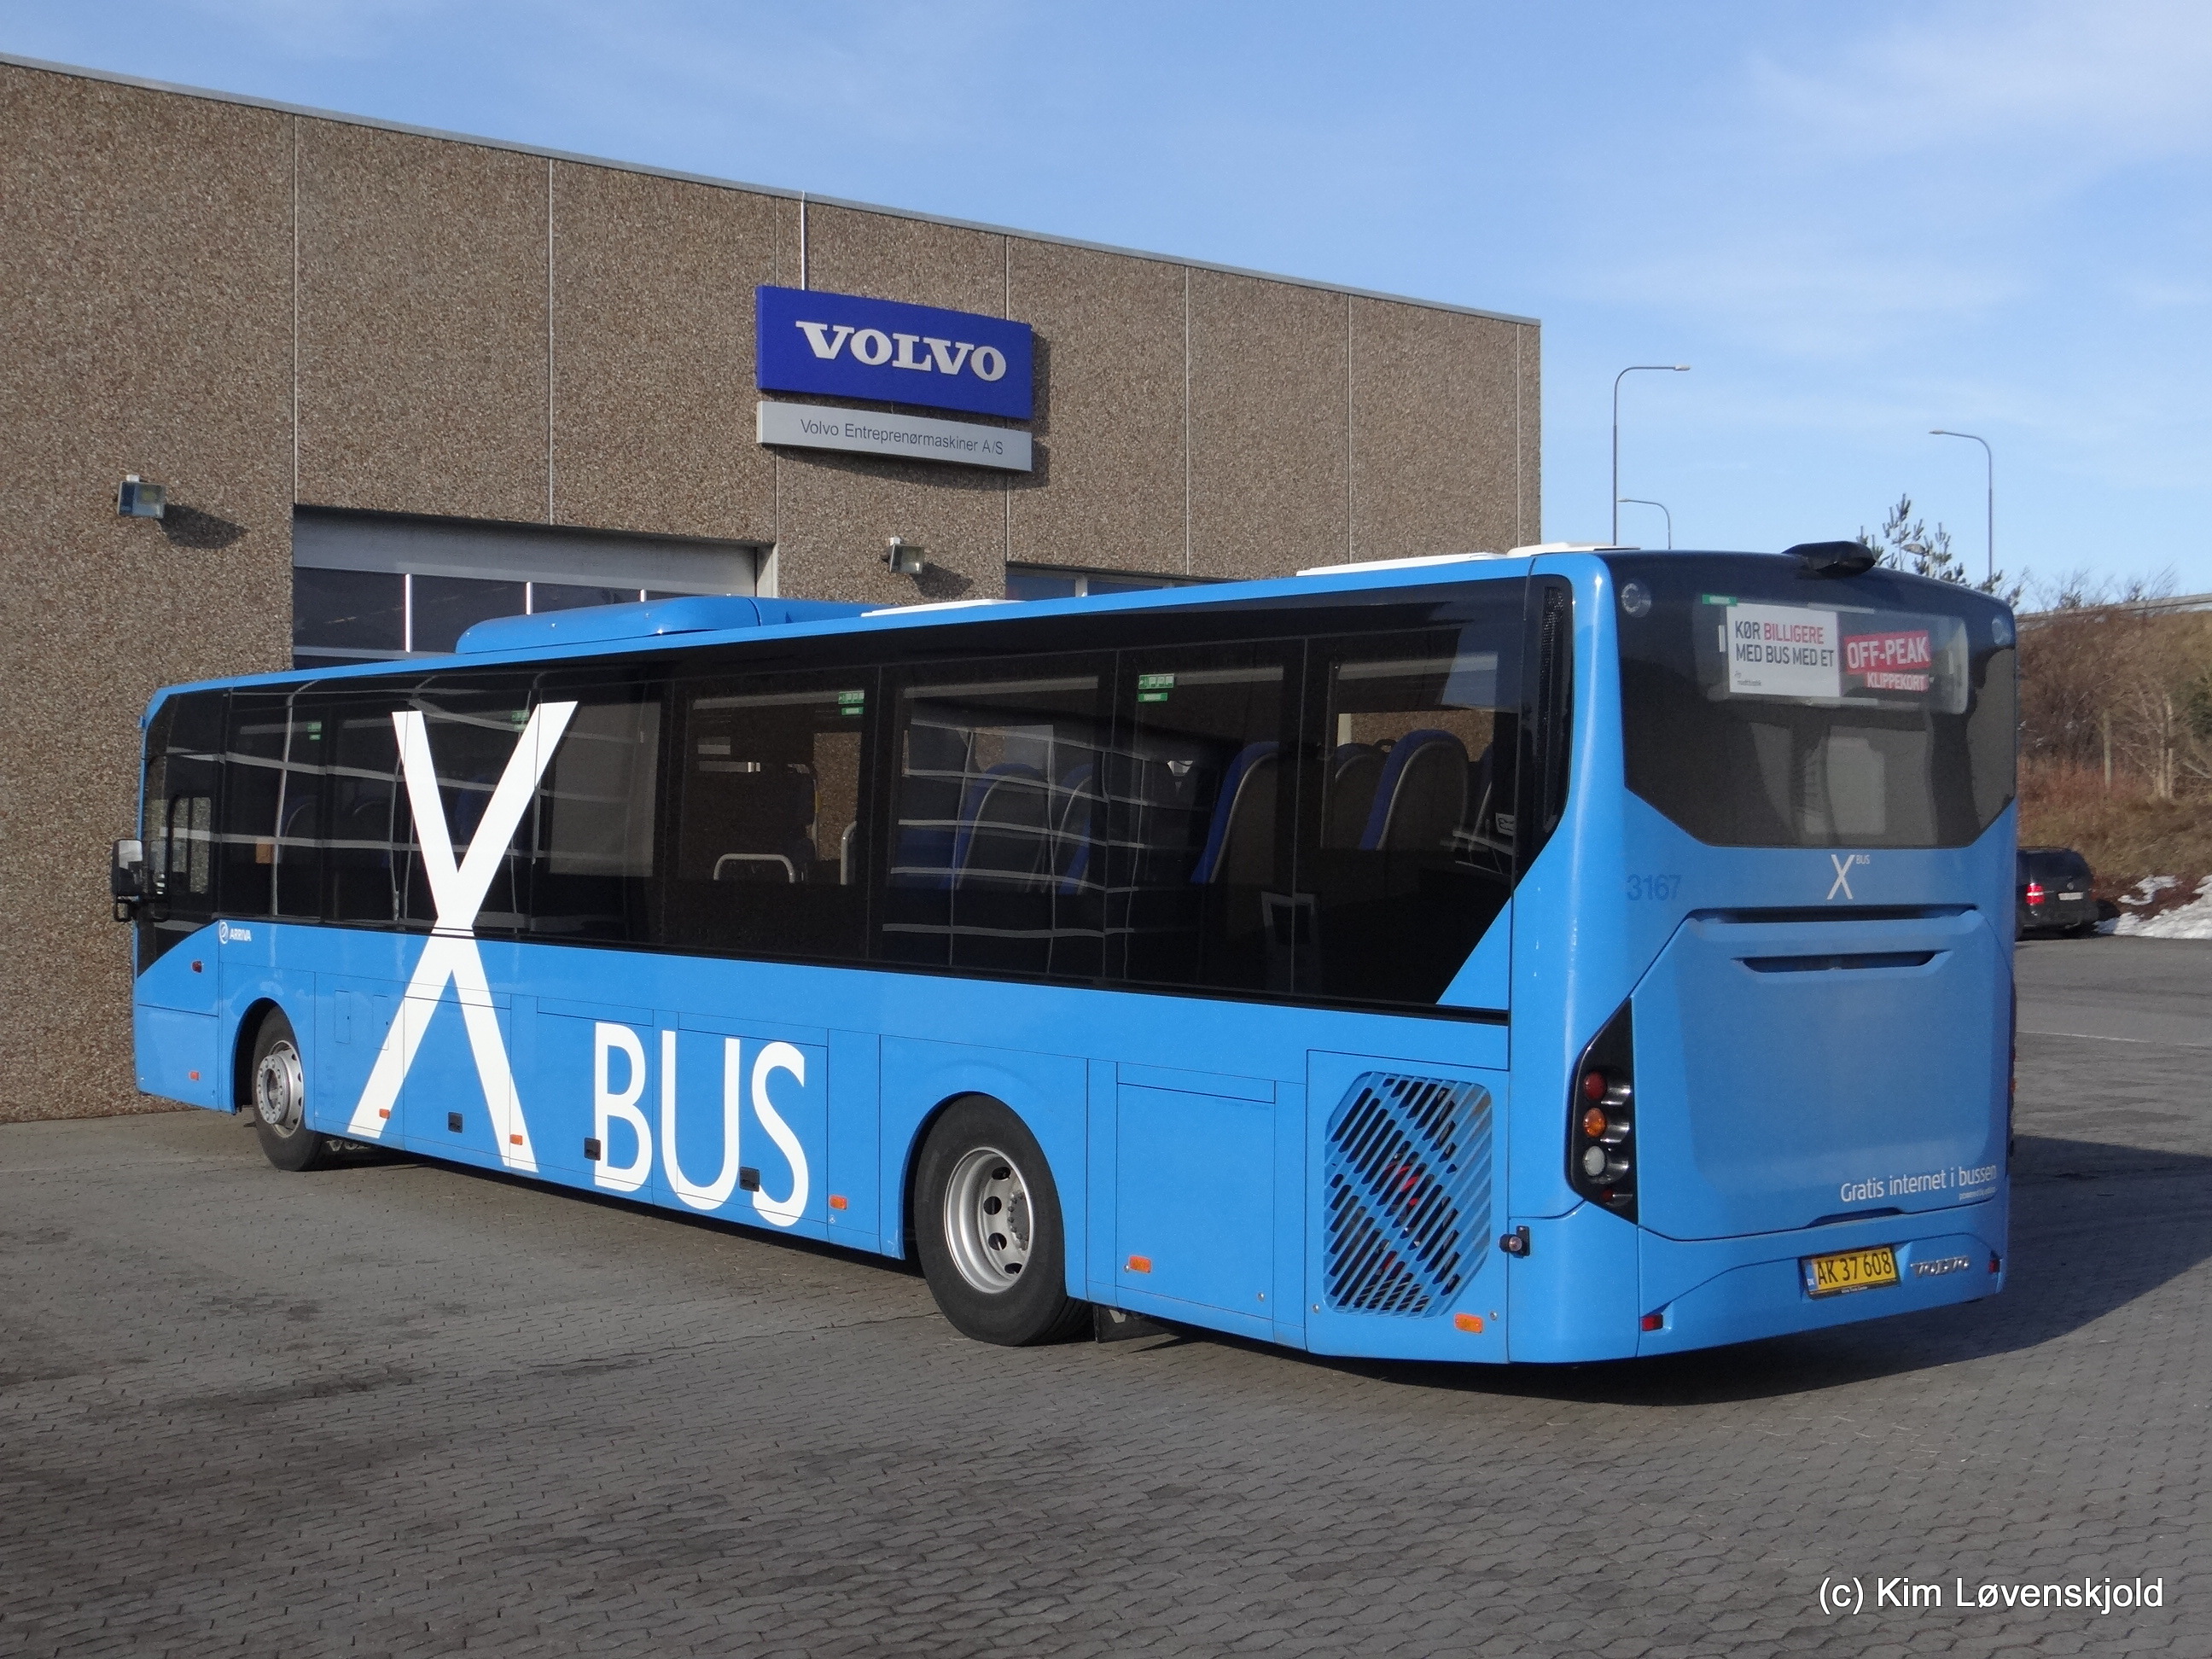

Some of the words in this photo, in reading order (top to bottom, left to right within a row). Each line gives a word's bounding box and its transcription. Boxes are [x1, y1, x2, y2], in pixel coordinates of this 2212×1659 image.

[795, 321, 1007, 381] VOLVO
[800, 419, 839, 436] Volvo
[845, 423, 978, 451] Entreprenørmaskiner
[982, 439, 1004, 455] A/S
[1735, 620, 1761, 640] KØR
[1763, 622, 1824, 645] BILLIGERE
[1736, 643, 1762, 662] MED
[1766, 645, 1790, 664] BUS
[1792, 648, 1817, 666] MED
[1820, 649, 1834, 667] ET
[1847, 637, 1930, 669] OFF-PEAK
[1866, 672, 1927, 691] KLIPPEKORT
[1626, 874, 1682, 901] 3167
[1826, 854, 1855, 900] X
[1855, 854, 1871, 864] BUS
[346, 701, 579, 1173] X
[595, 1022, 810, 1227] BUS
[1841, 1177, 1884, 1202] Gratis
[1889, 1169, 1947, 1196] internet
[1950, 1167, 1955, 1187] i
[1959, 1164, 1997, 1186] bussen
[1816, 1260, 1838, 1285] AK
[1840, 1256, 1857, 1281] 37
[1863, 1251, 1892, 1278] 608
